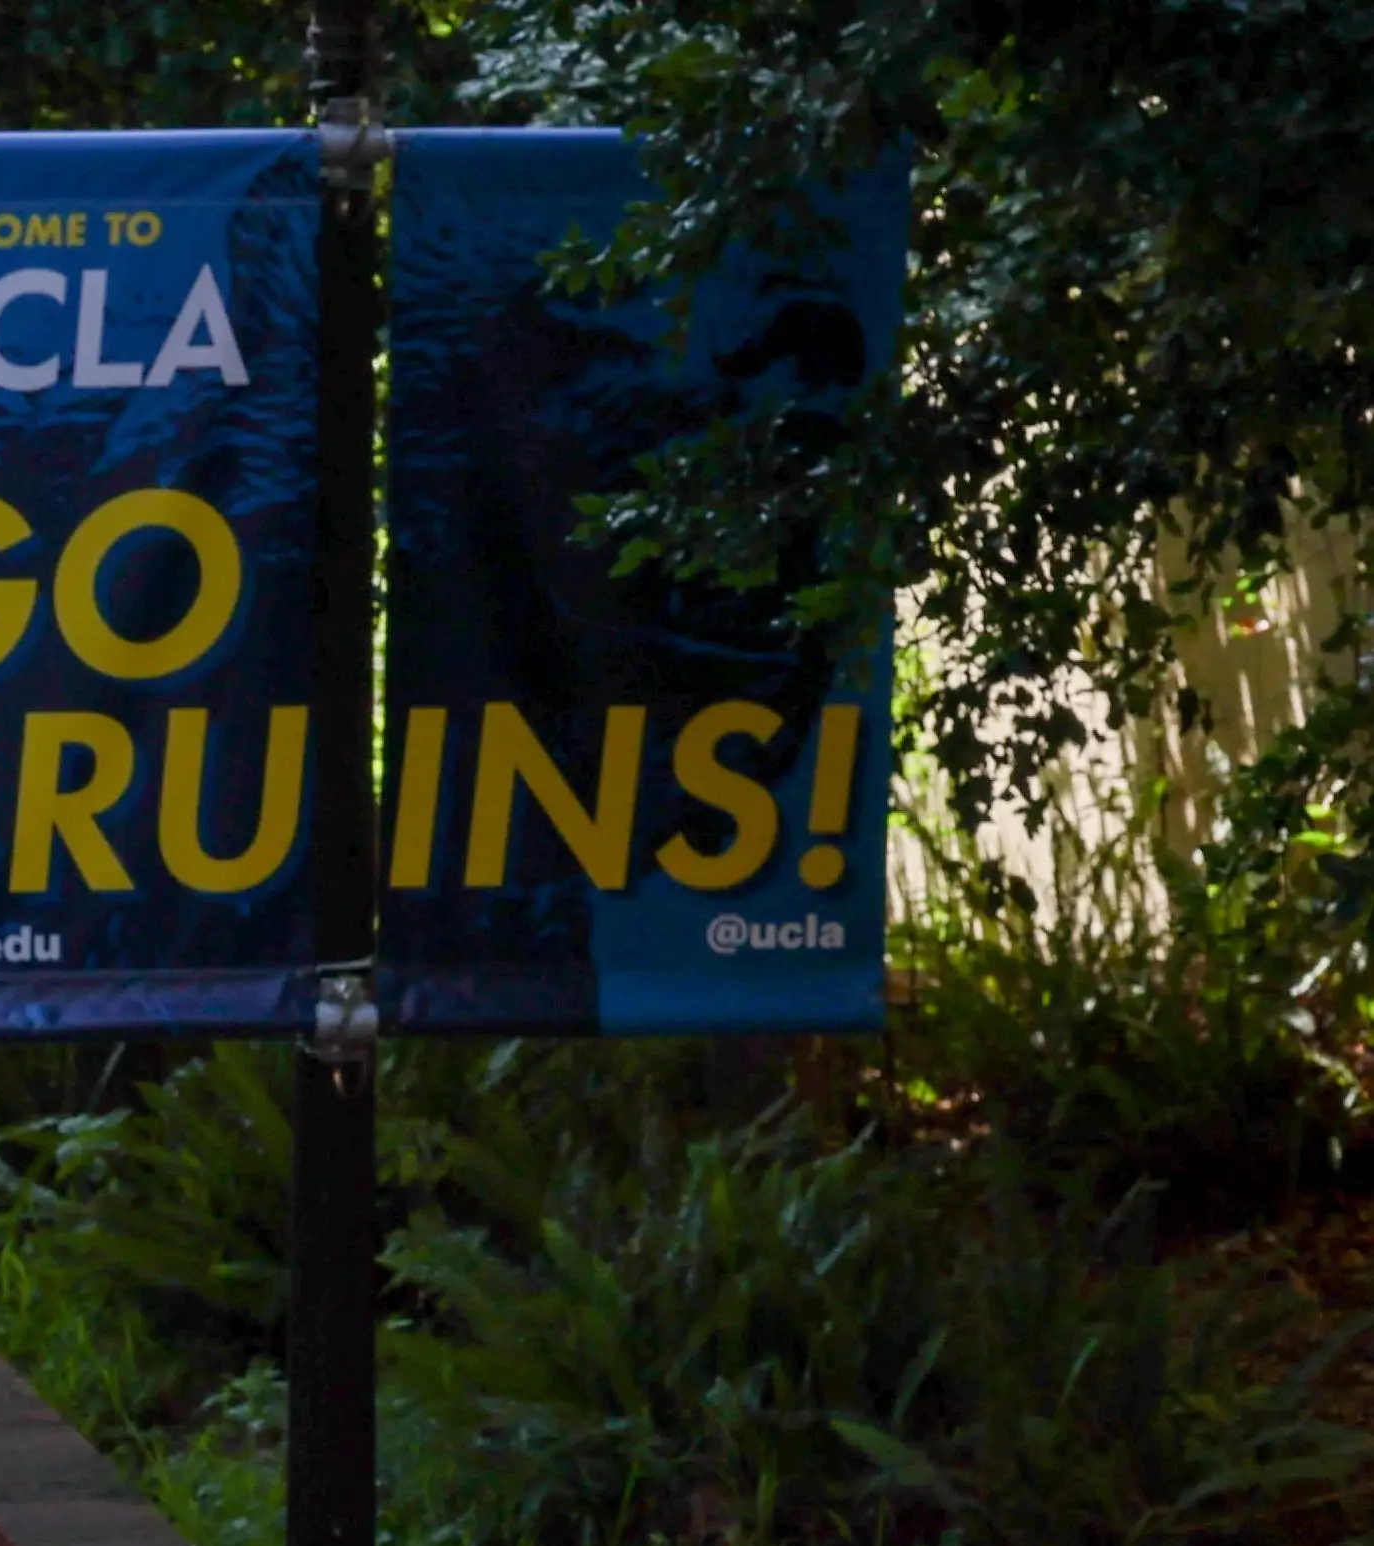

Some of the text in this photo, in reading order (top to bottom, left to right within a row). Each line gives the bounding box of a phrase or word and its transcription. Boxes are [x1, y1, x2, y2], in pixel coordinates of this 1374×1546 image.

[103, 212, 163, 246] TO
[387, 700, 860, 890] INS!
[705, 912, 846, 955] @ucla
